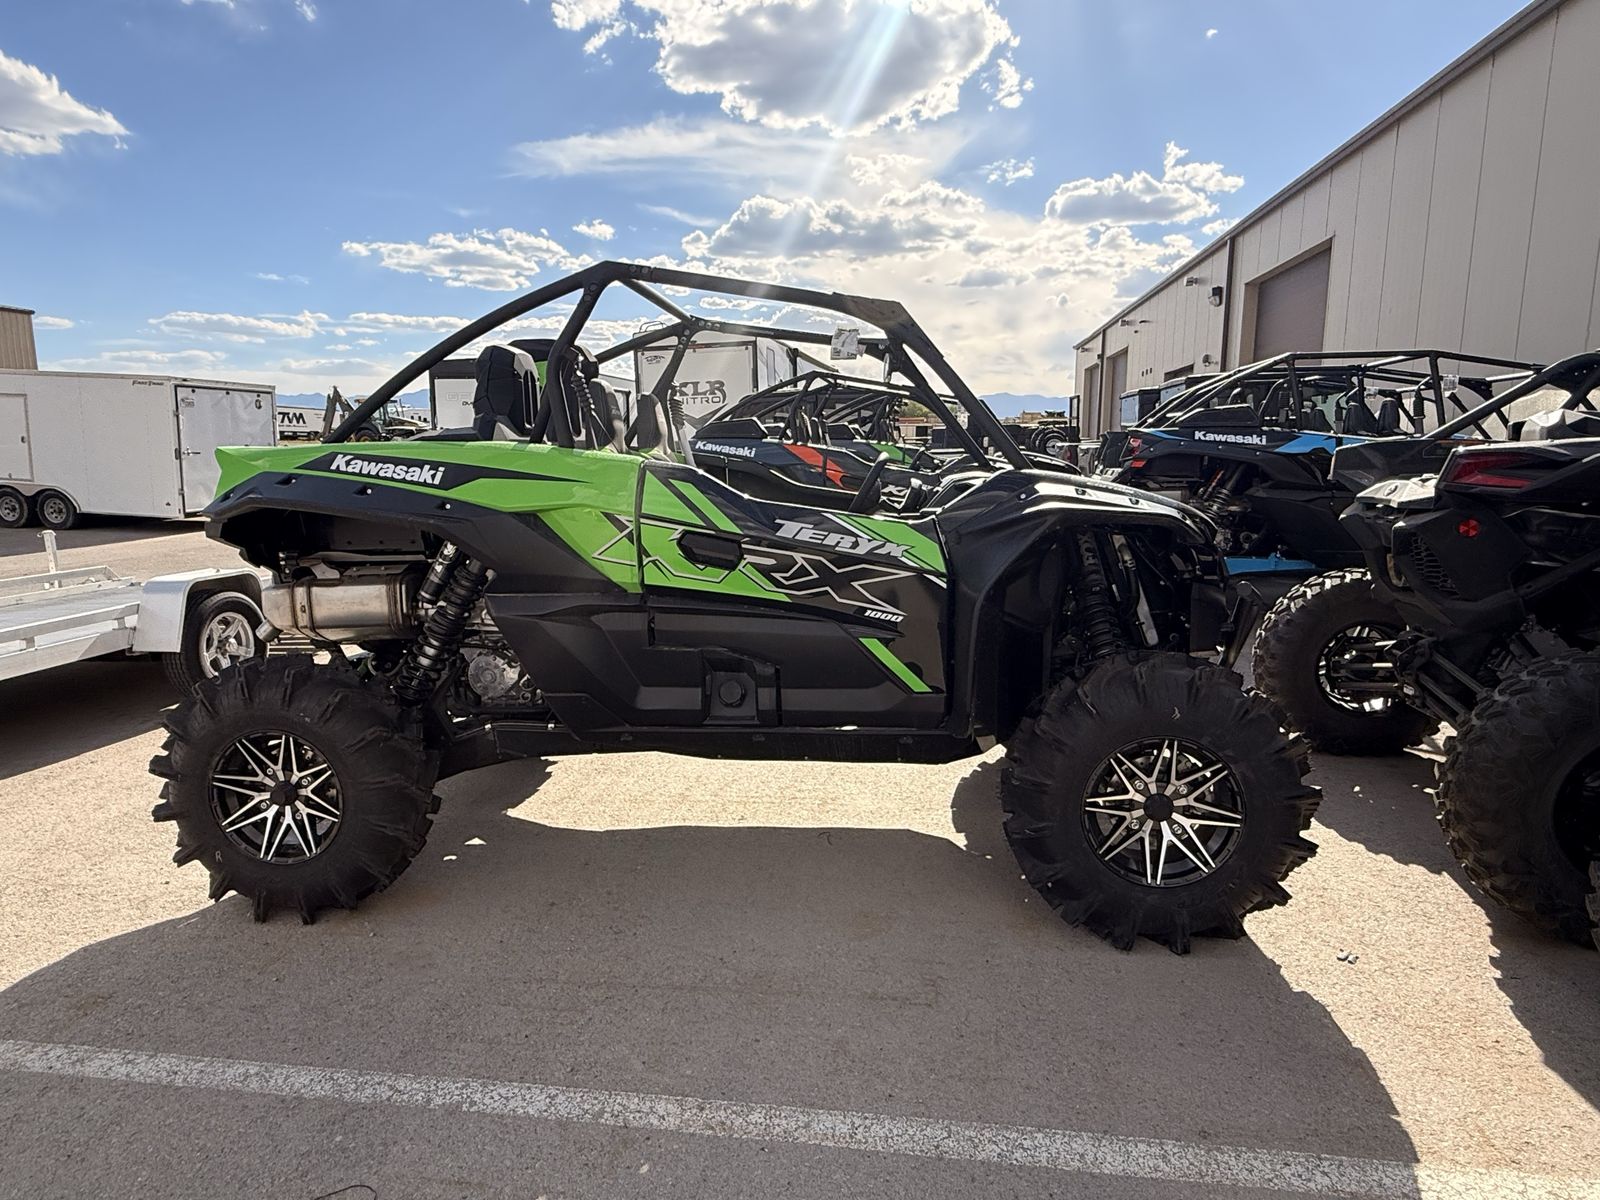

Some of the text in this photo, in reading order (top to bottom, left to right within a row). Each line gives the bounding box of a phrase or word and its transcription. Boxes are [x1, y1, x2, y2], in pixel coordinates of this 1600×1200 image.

[1194, 430, 1267, 445] Kawasaki
[695, 440, 757, 458] Kawasaki
[330, 454, 446, 485] Kawasaki
[863, 609, 905, 623] 1000
